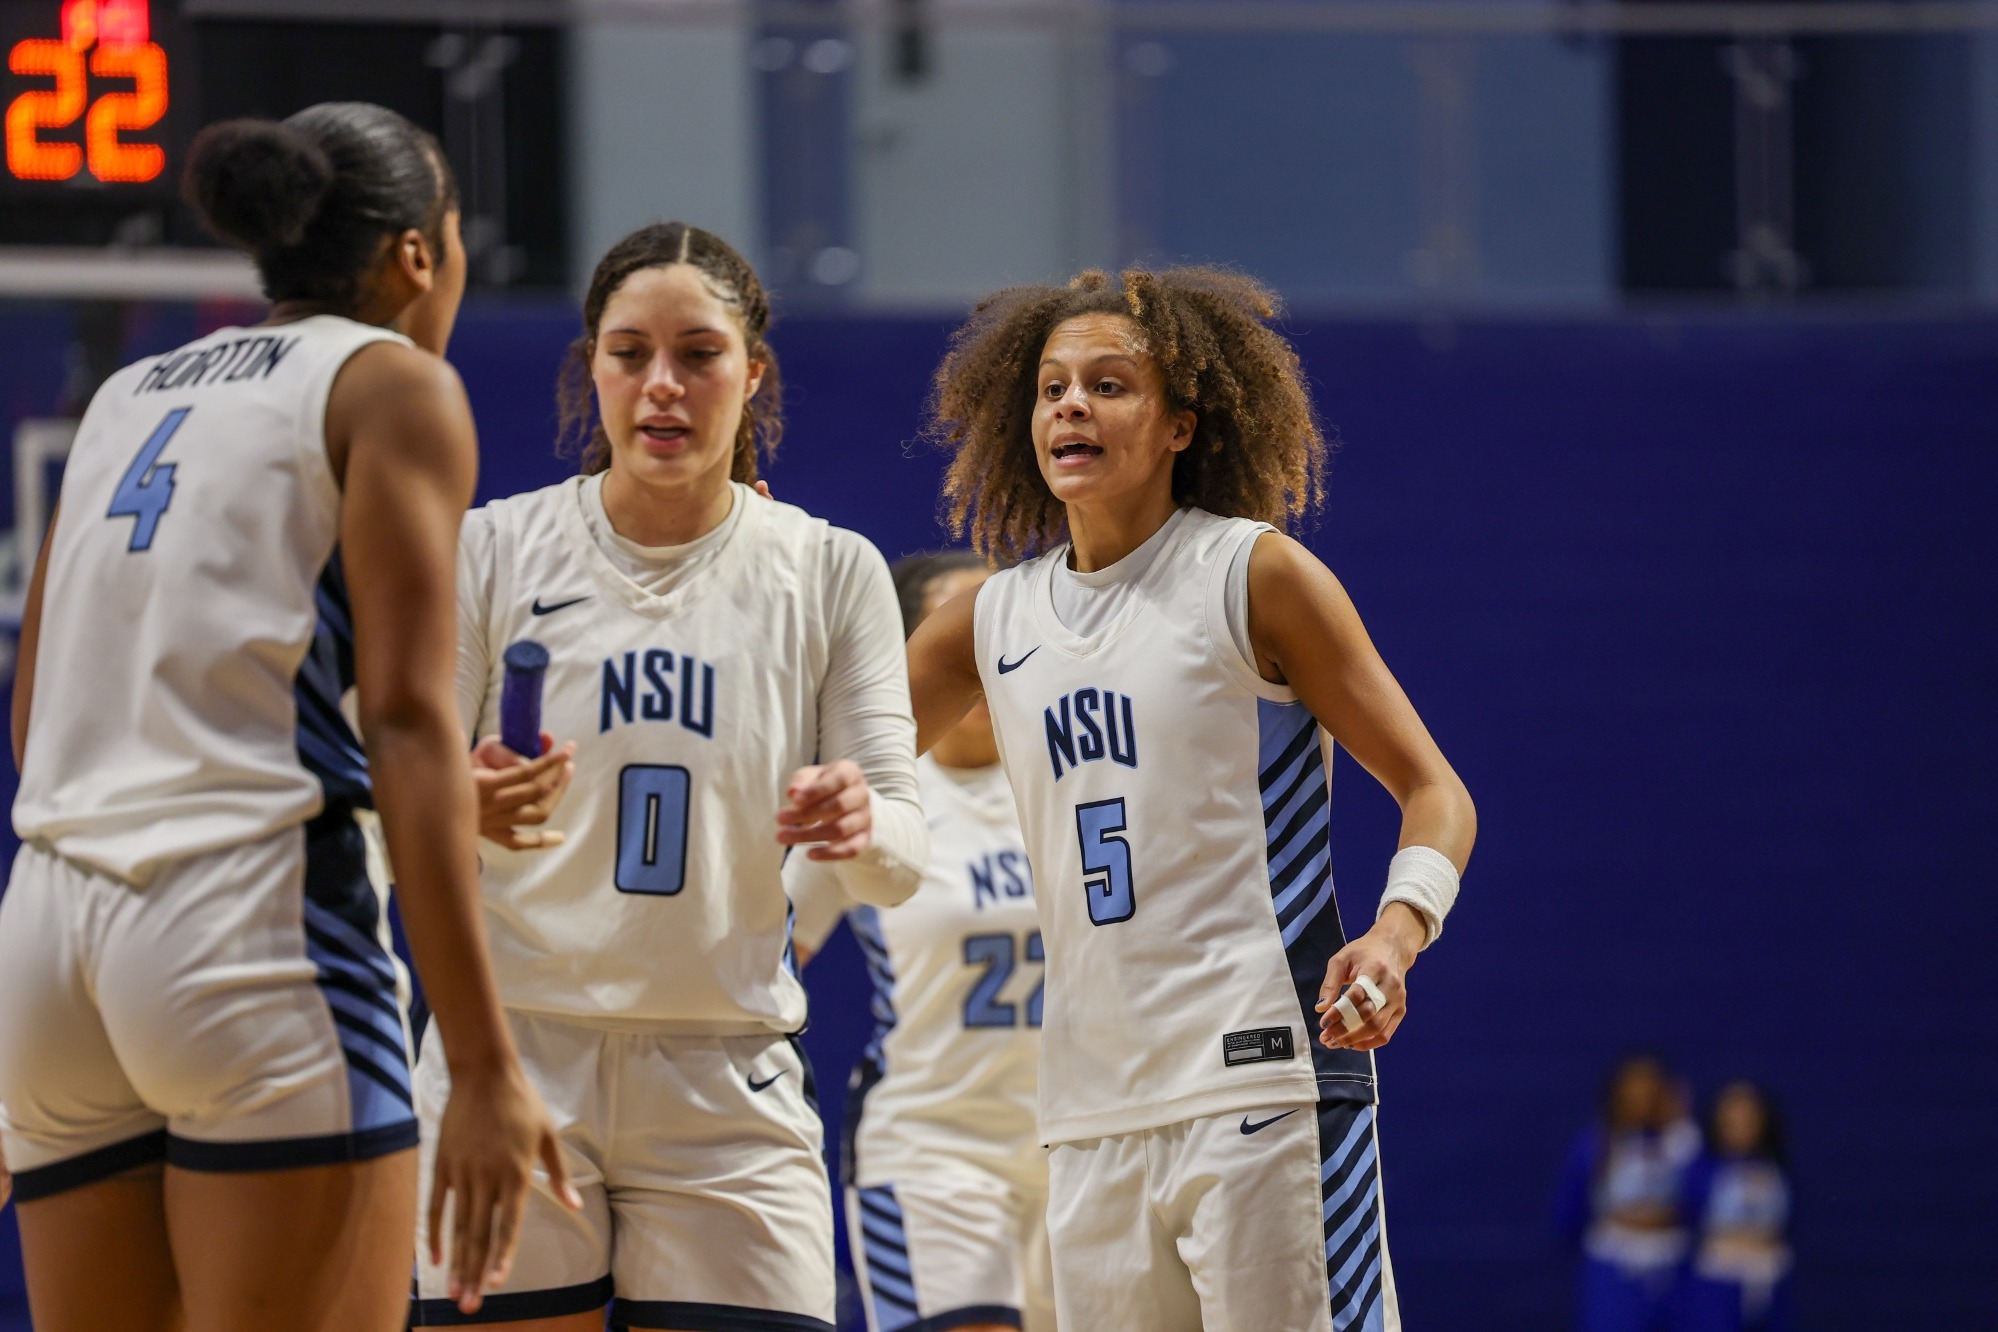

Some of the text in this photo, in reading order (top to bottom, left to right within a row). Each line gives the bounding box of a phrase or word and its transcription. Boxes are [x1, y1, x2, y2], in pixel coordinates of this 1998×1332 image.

[5, 38, 168, 182] 22
[132, 335, 301, 397] HORTON
[105, 406, 193, 553] 4
[600, 649, 714, 739] NSU
[1044, 687, 1138, 782] NSU
[614, 764, 690, 895] 0
[1075, 797, 1136, 926] 5
[1271, 1036, 1283, 1050] M
